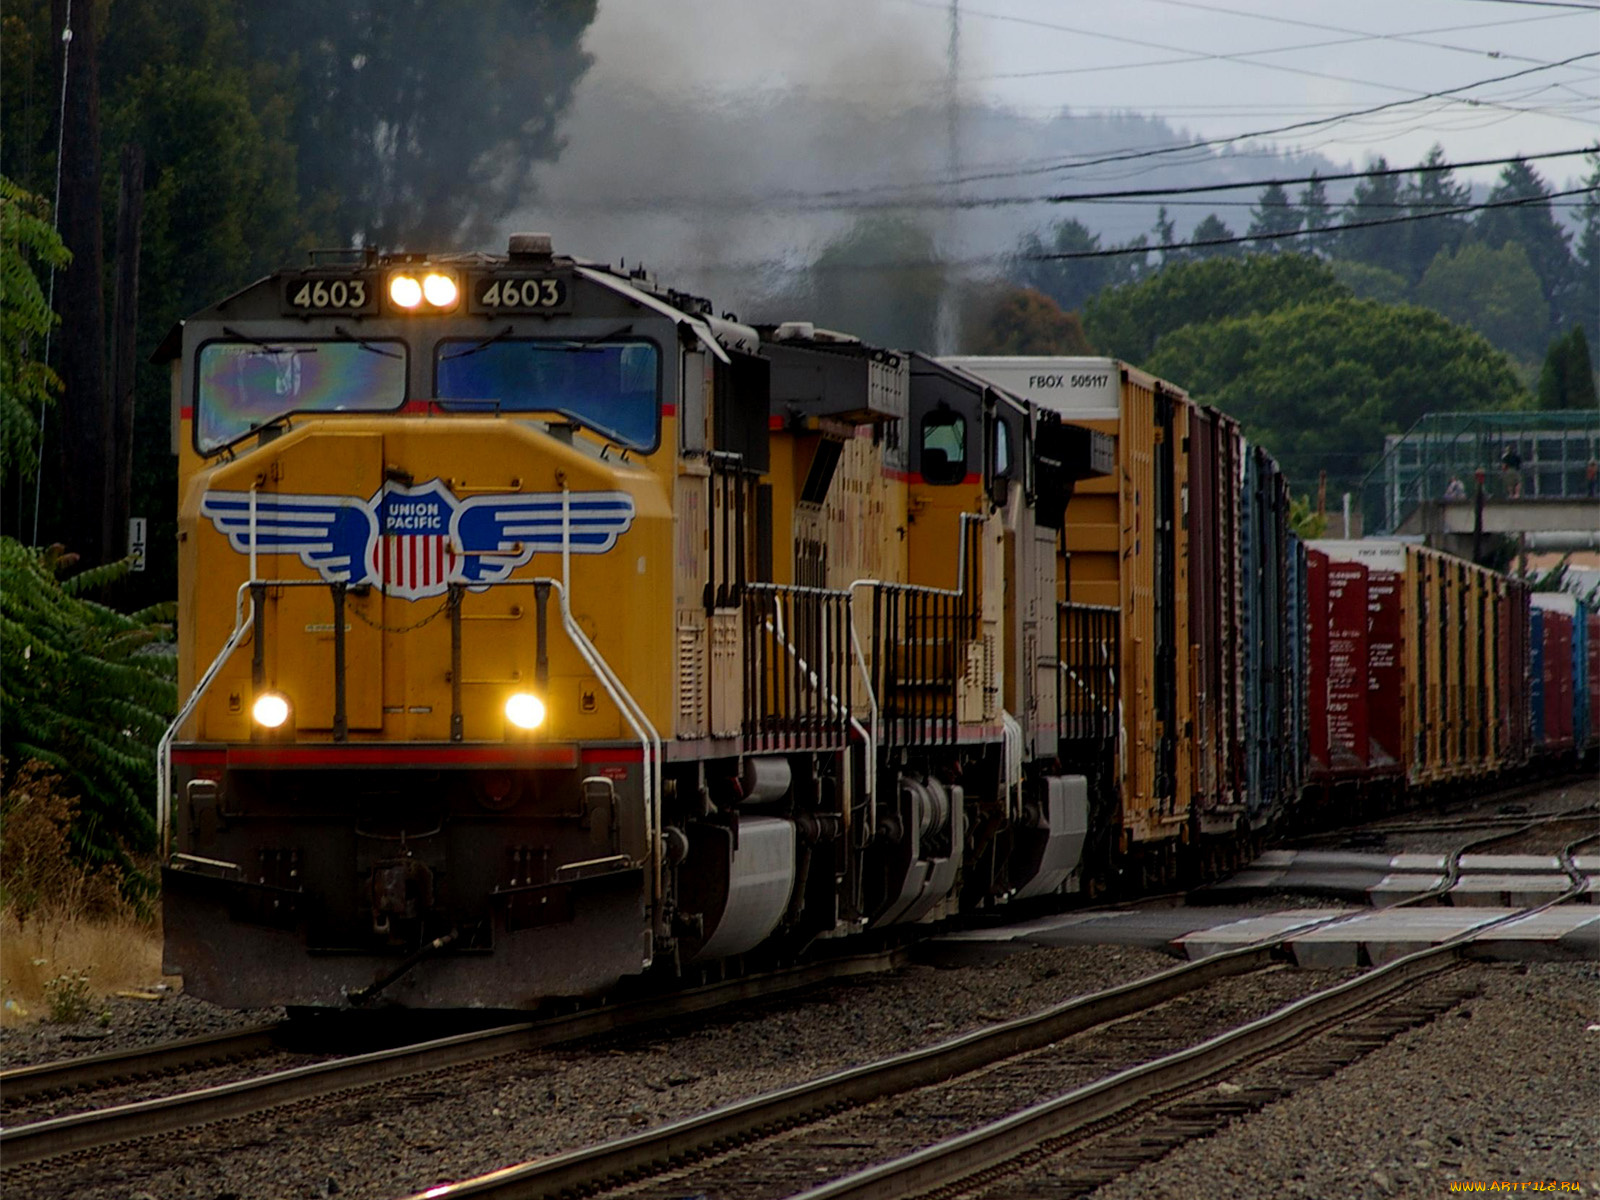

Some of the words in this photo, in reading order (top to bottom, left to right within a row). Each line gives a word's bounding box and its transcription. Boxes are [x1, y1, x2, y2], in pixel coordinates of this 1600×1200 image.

[293, 280, 366, 308] 4603
[482, 279, 559, 308] 4603
[1028, 374, 1064, 389] FBOX
[388, 502, 439, 516] UNION
[386, 516, 442, 529] PACIFIC
